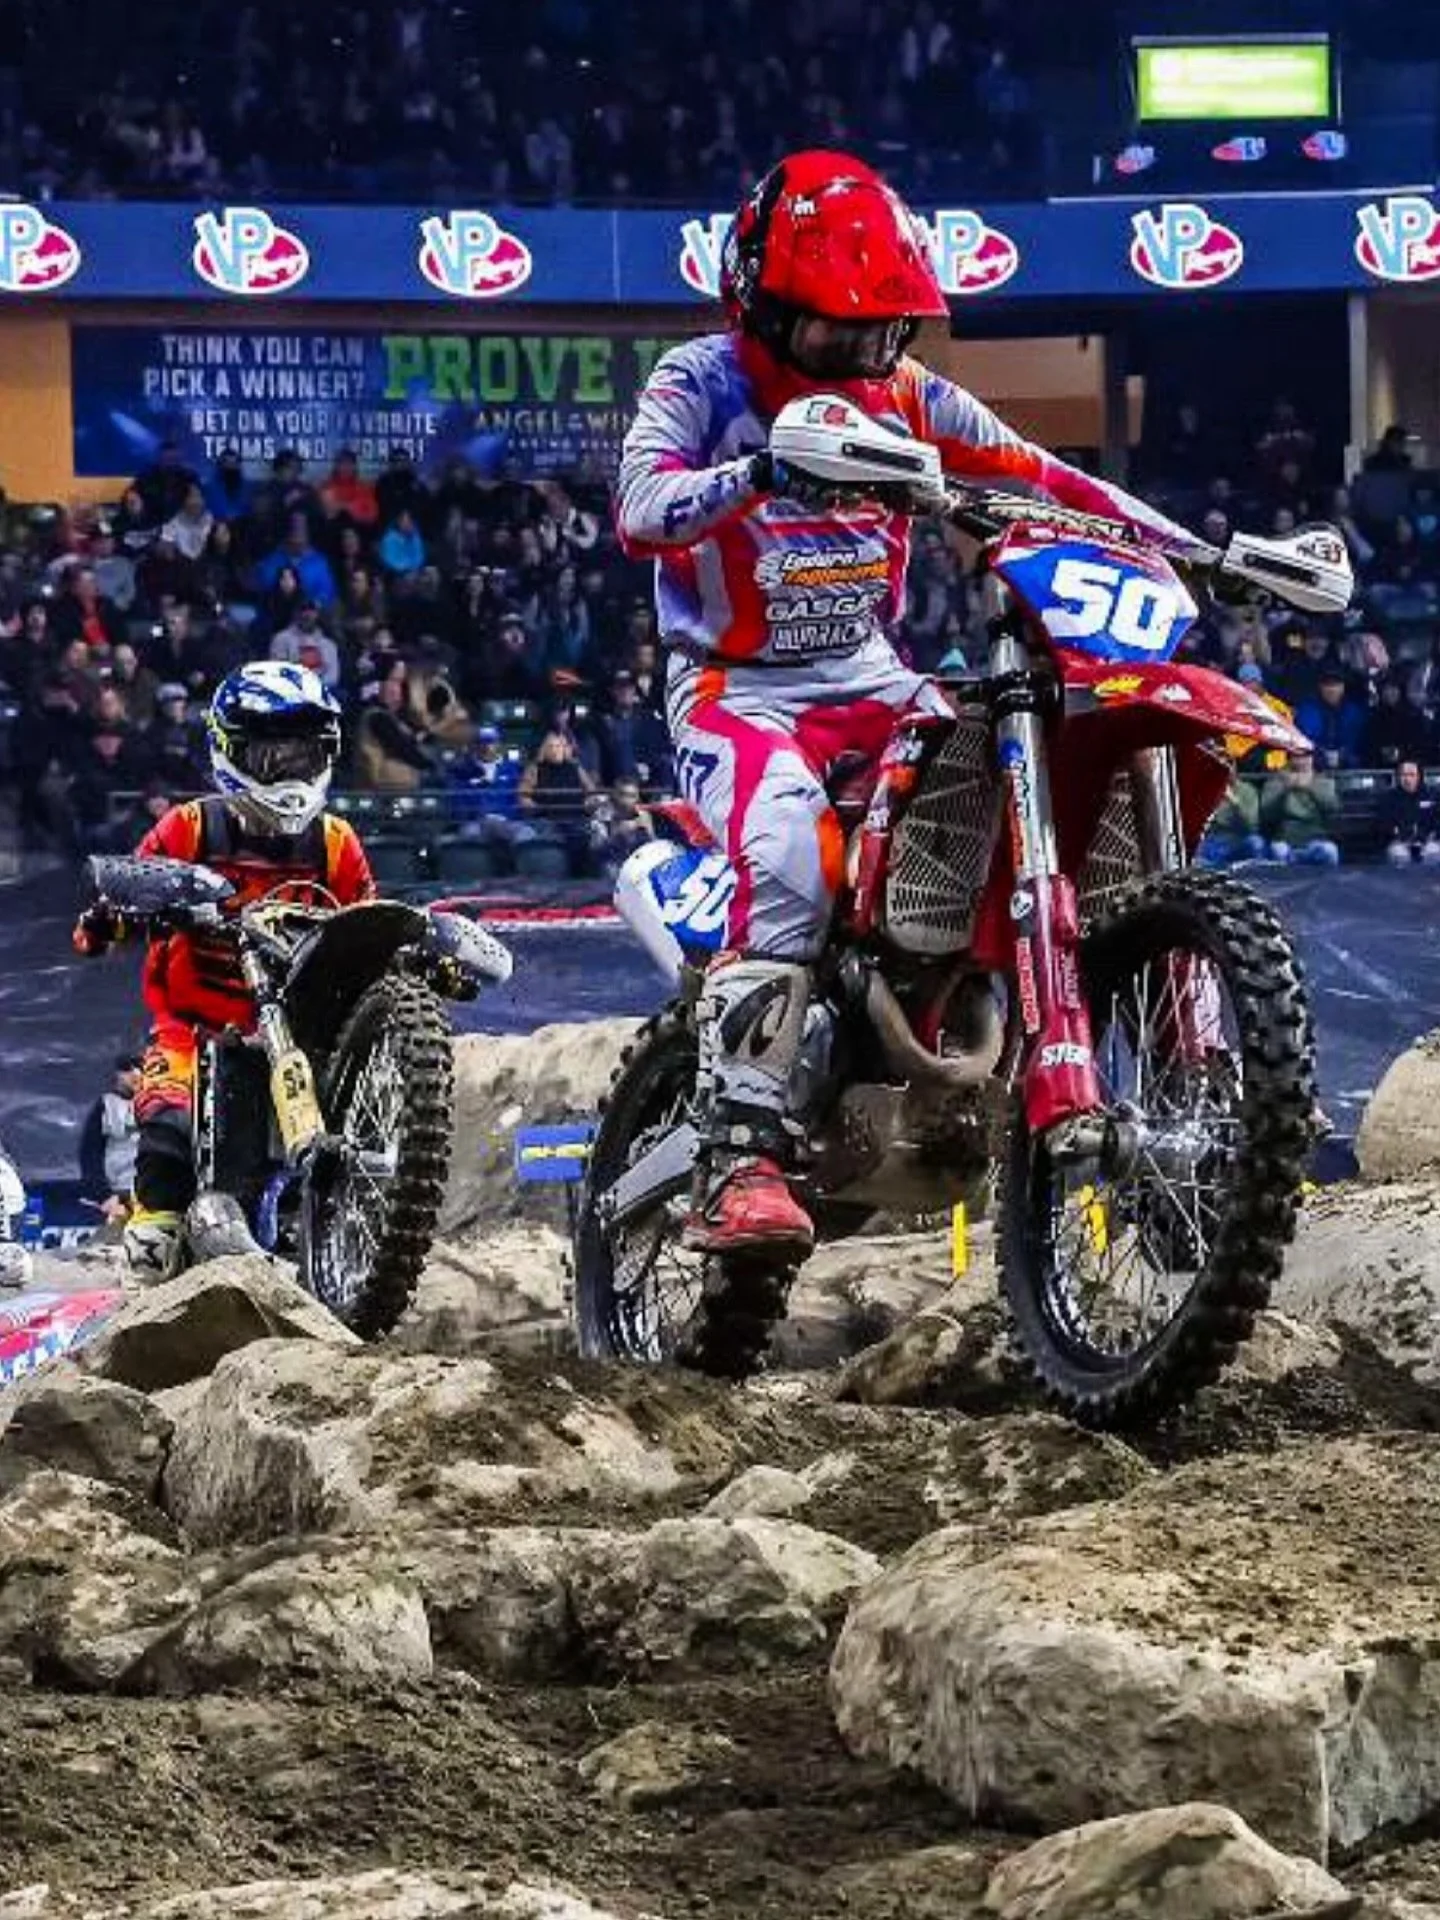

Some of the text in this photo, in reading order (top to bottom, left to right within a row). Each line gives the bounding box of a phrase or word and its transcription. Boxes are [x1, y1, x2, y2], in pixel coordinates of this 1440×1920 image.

[195, 207, 274, 292] VP
[420, 211, 497, 296] VP
[1132, 203, 1211, 287] VP
[1356, 198, 1434, 279] VP
[144, 367, 364, 399] PICK A WINNER?
[162, 336, 364, 364] THINK YOU CAN
[381, 336, 615, 403] PROVE
[190, 409, 437, 435] BET ON YOUR FAVORITE
[203, 436, 275, 460] TEAMS
[473, 408, 564, 434] ANGEL
[1042, 558, 1178, 651] 50
[663, 854, 738, 933] 50
